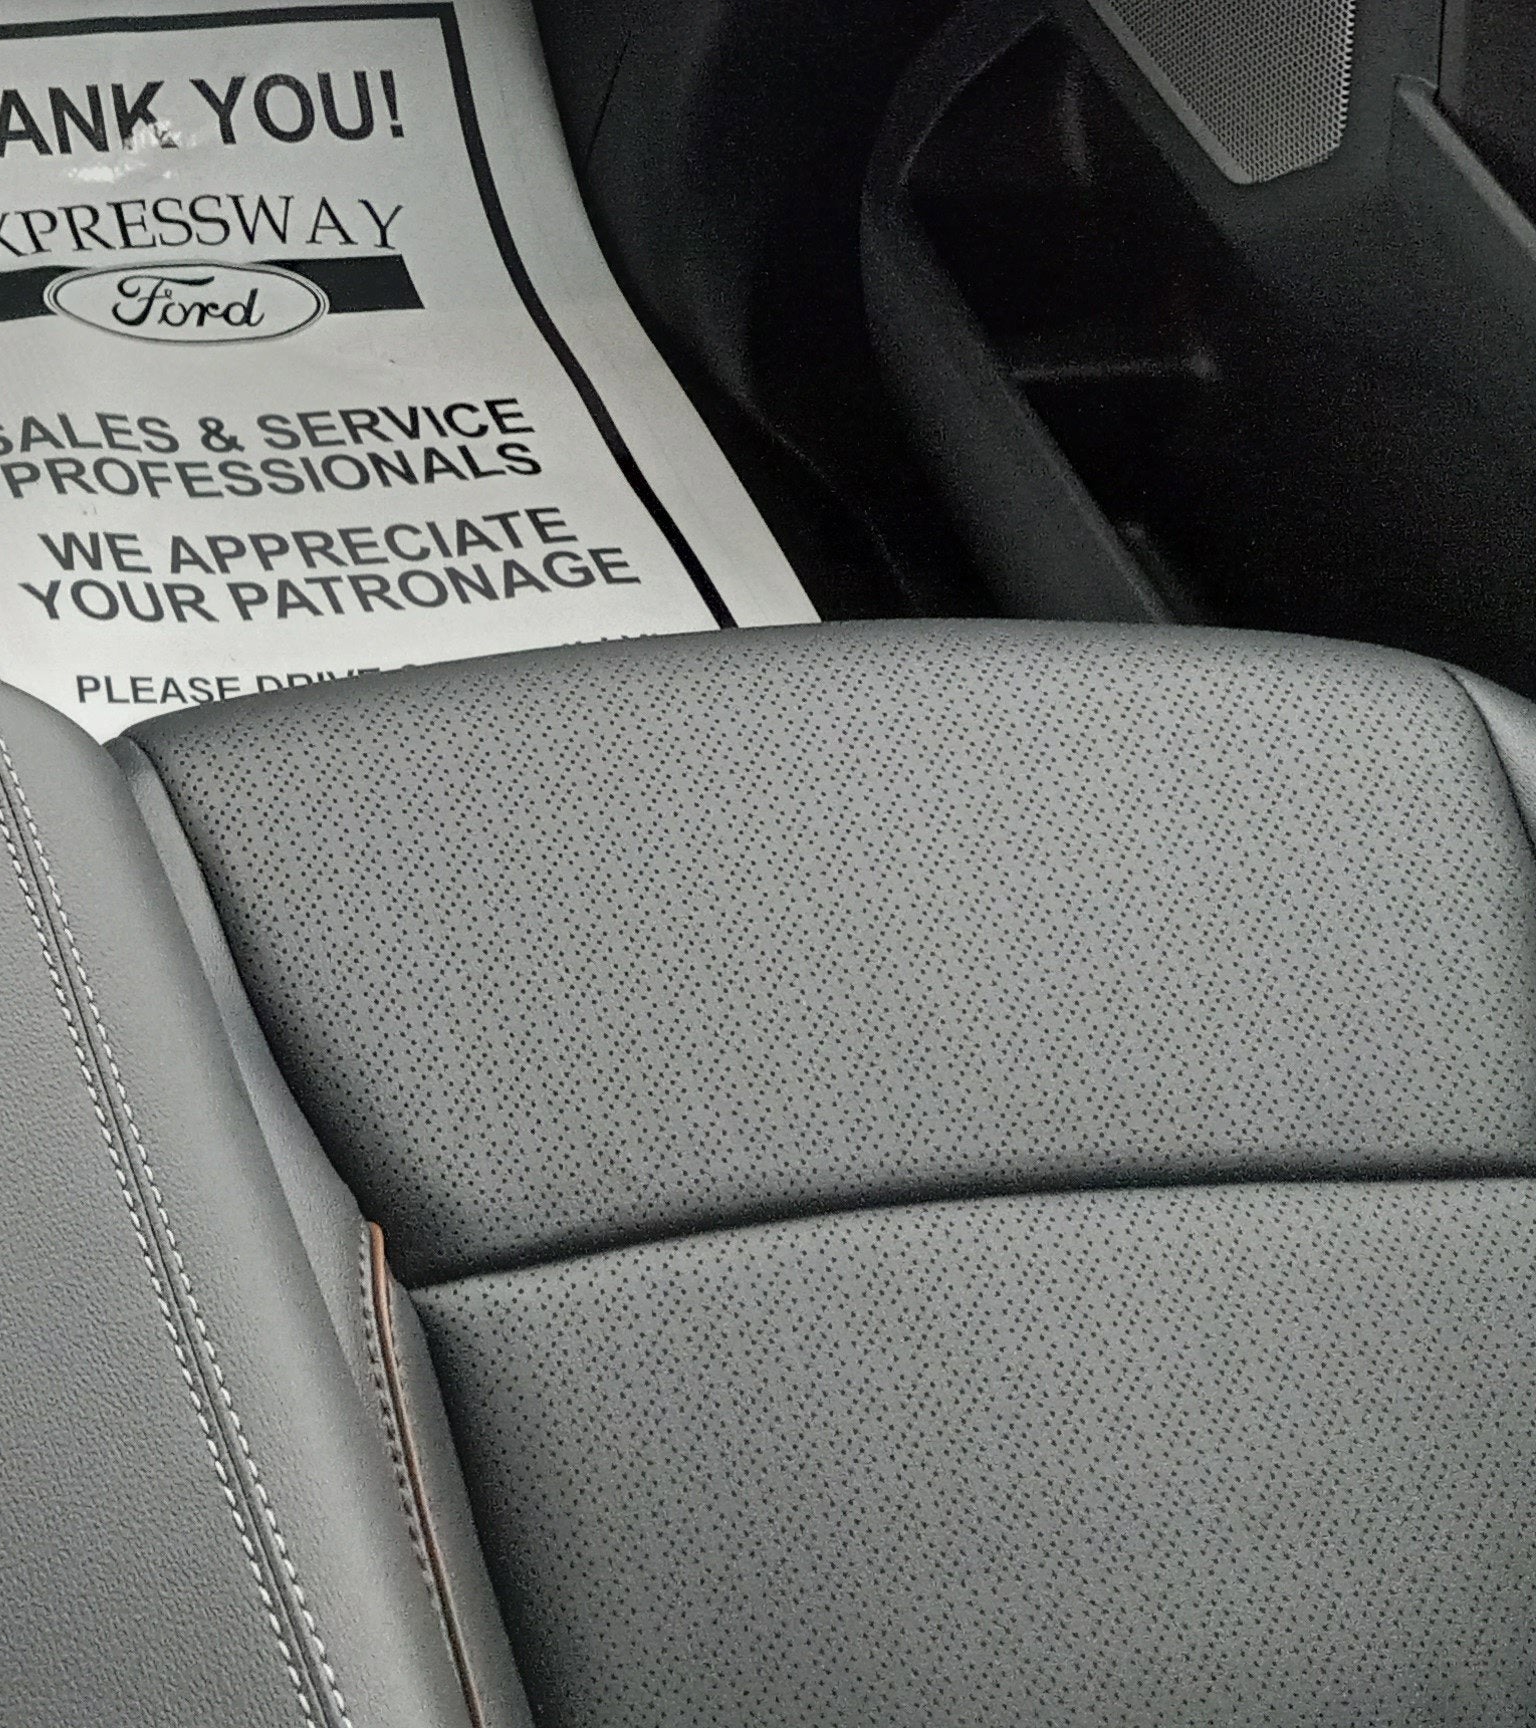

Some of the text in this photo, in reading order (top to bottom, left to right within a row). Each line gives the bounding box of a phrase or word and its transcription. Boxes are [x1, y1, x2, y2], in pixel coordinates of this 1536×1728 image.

[189, 69, 405, 145] YOU!
[112, 274, 265, 328] Ford
[198, 415, 246, 454] &
[254, 397, 536, 451] SERVICE
[37, 506, 578, 573] WE APPRECIATE
[18, 546, 641, 623] YOUR PATRONAGE
[75, 674, 241, 705] PLEASE
